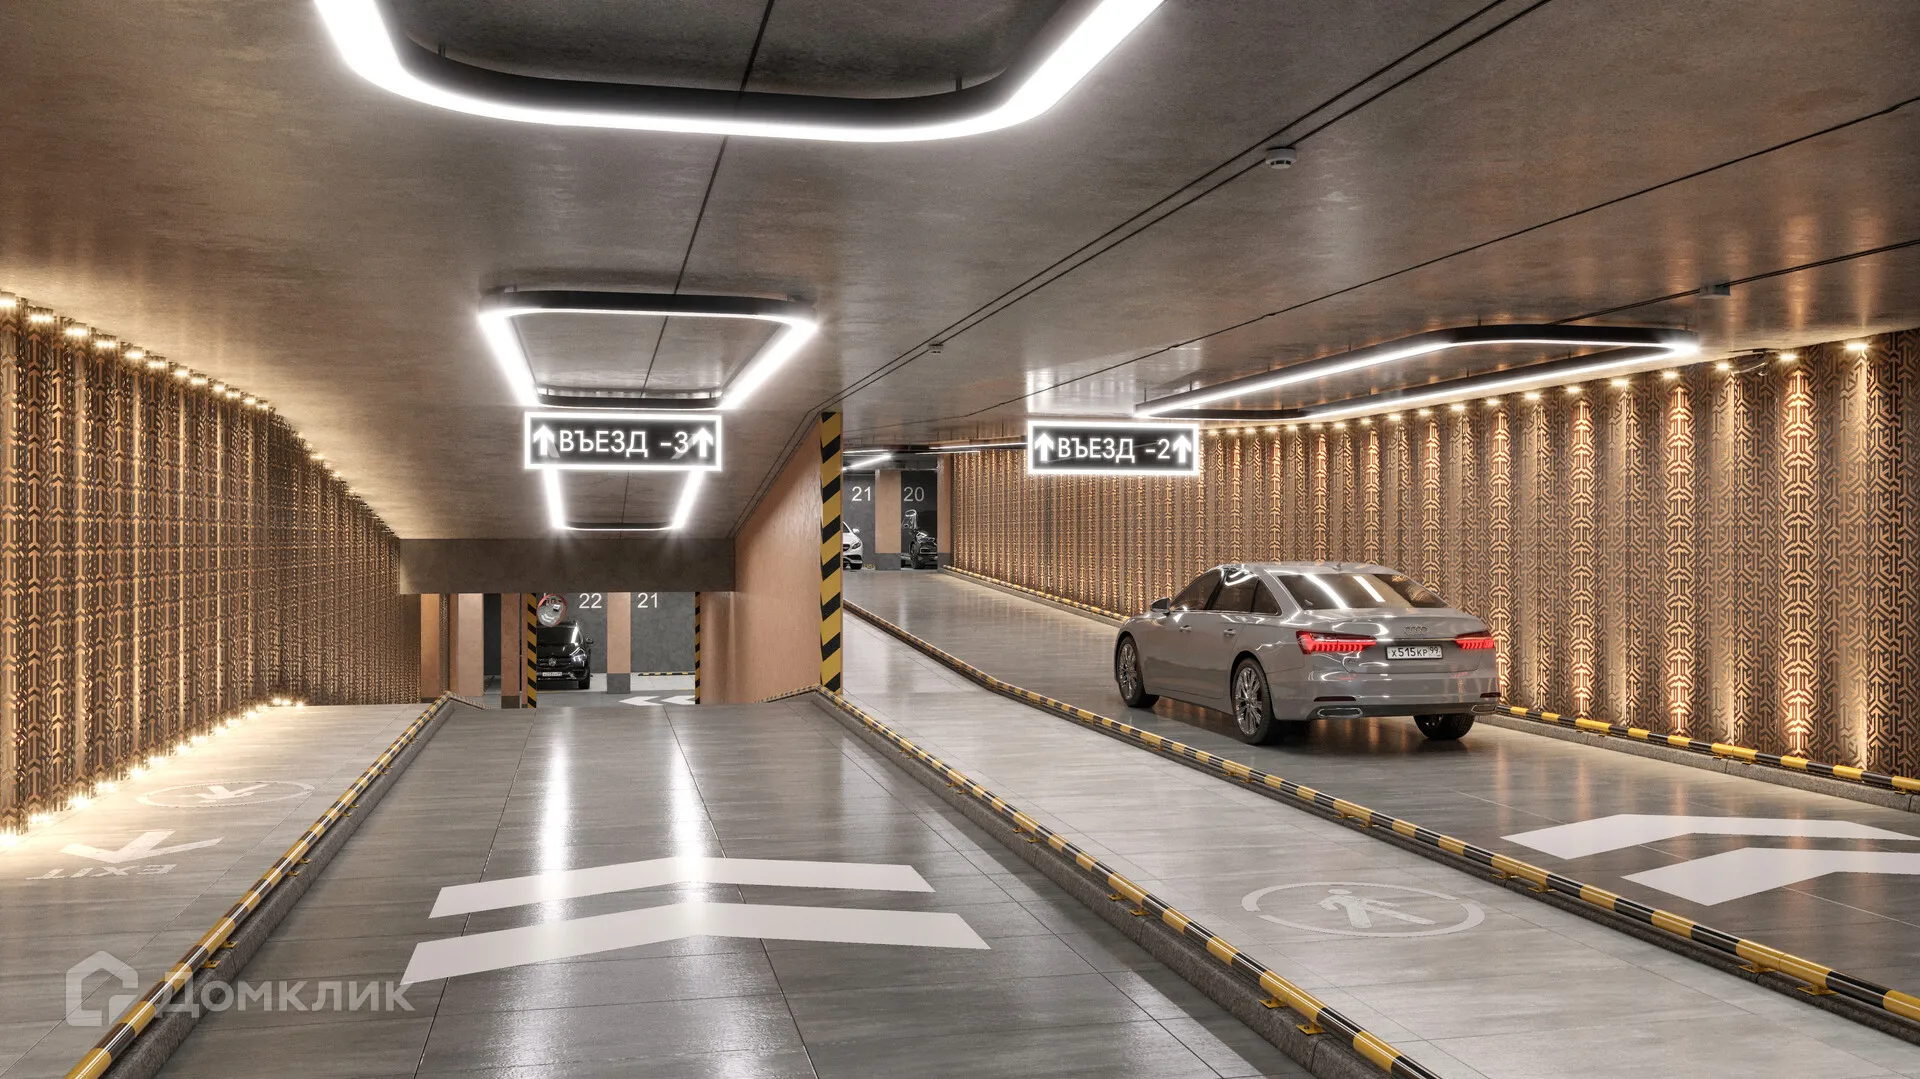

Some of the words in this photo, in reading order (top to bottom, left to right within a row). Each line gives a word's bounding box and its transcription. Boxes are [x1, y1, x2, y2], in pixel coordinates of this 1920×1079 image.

[559, 429, 649, 458] ВЪЕЗД
[660, 430, 690, 454] -3
[1058, 437, 1136, 464] ВЪЕЗД
[1145, 438, 1171, 460] -2
[851, 486, 872, 502] 21
[903, 486, 925, 502] 20
[578, 592, 603, 609] 22
[637, 592, 658, 609] 21
[25, 863, 178, 881] EXIT
